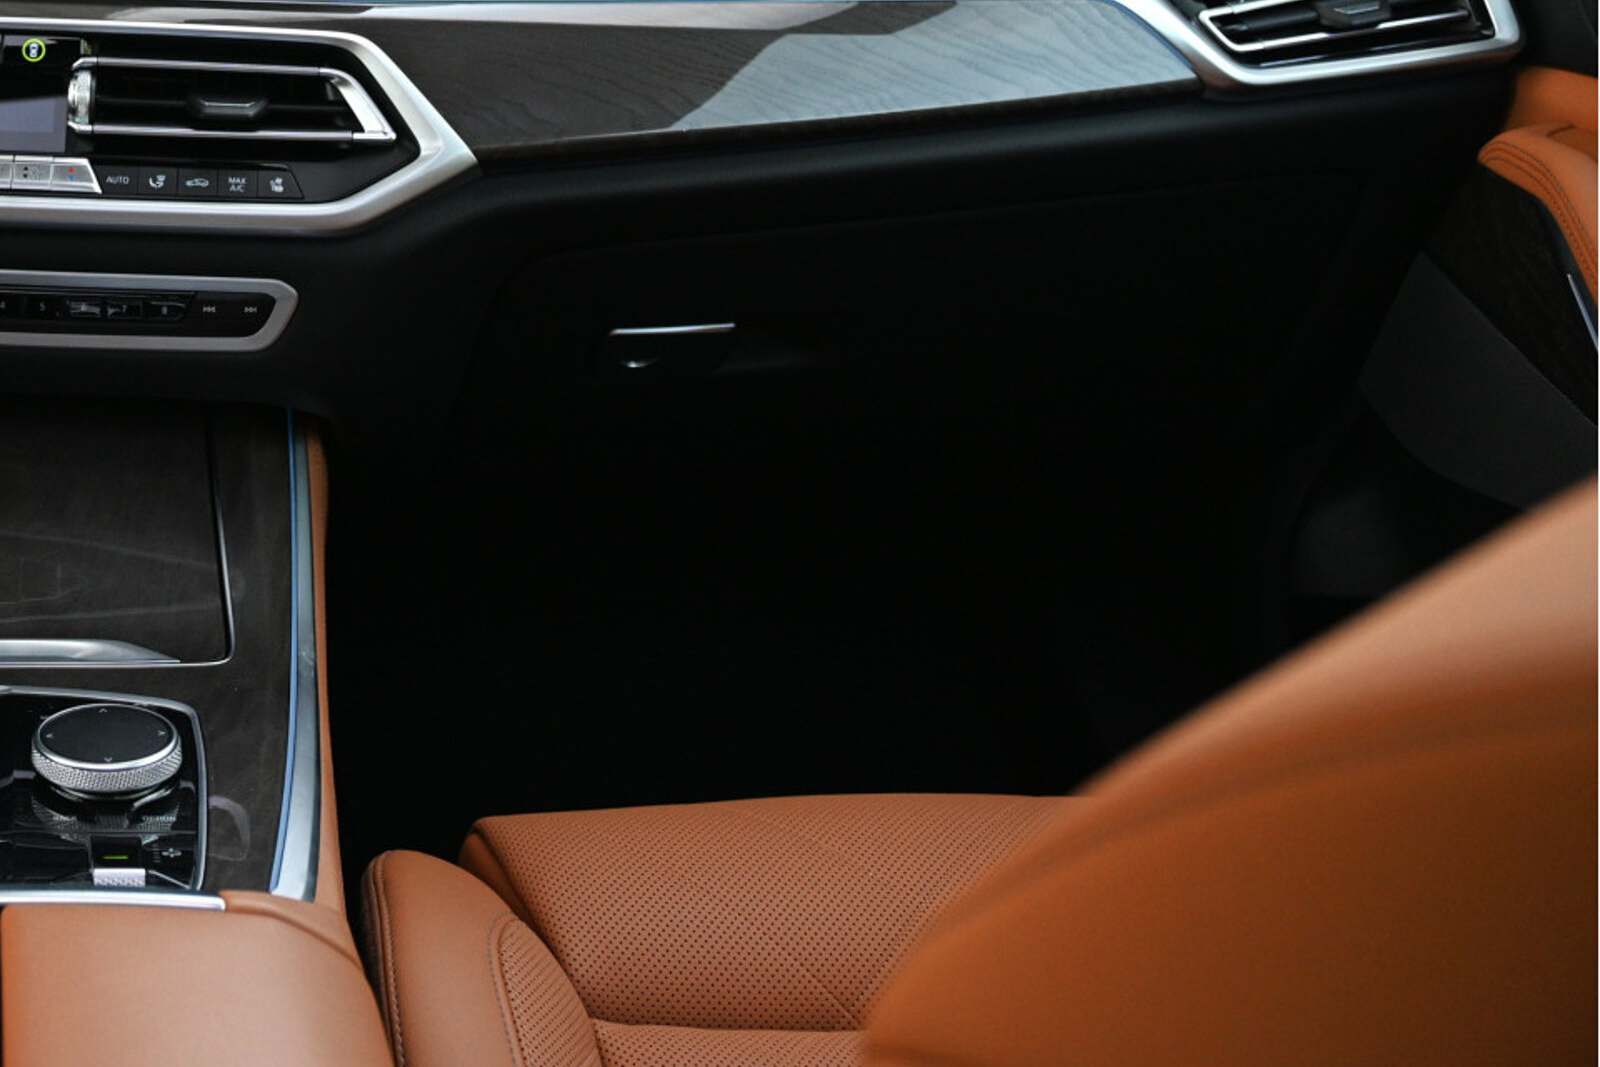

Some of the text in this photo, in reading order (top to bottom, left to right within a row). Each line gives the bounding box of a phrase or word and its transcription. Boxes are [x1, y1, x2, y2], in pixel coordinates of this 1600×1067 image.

[105, 175, 130, 185] AUTO
[227, 176, 247, 184] MAX
[229, 184, 245, 193] A/C
